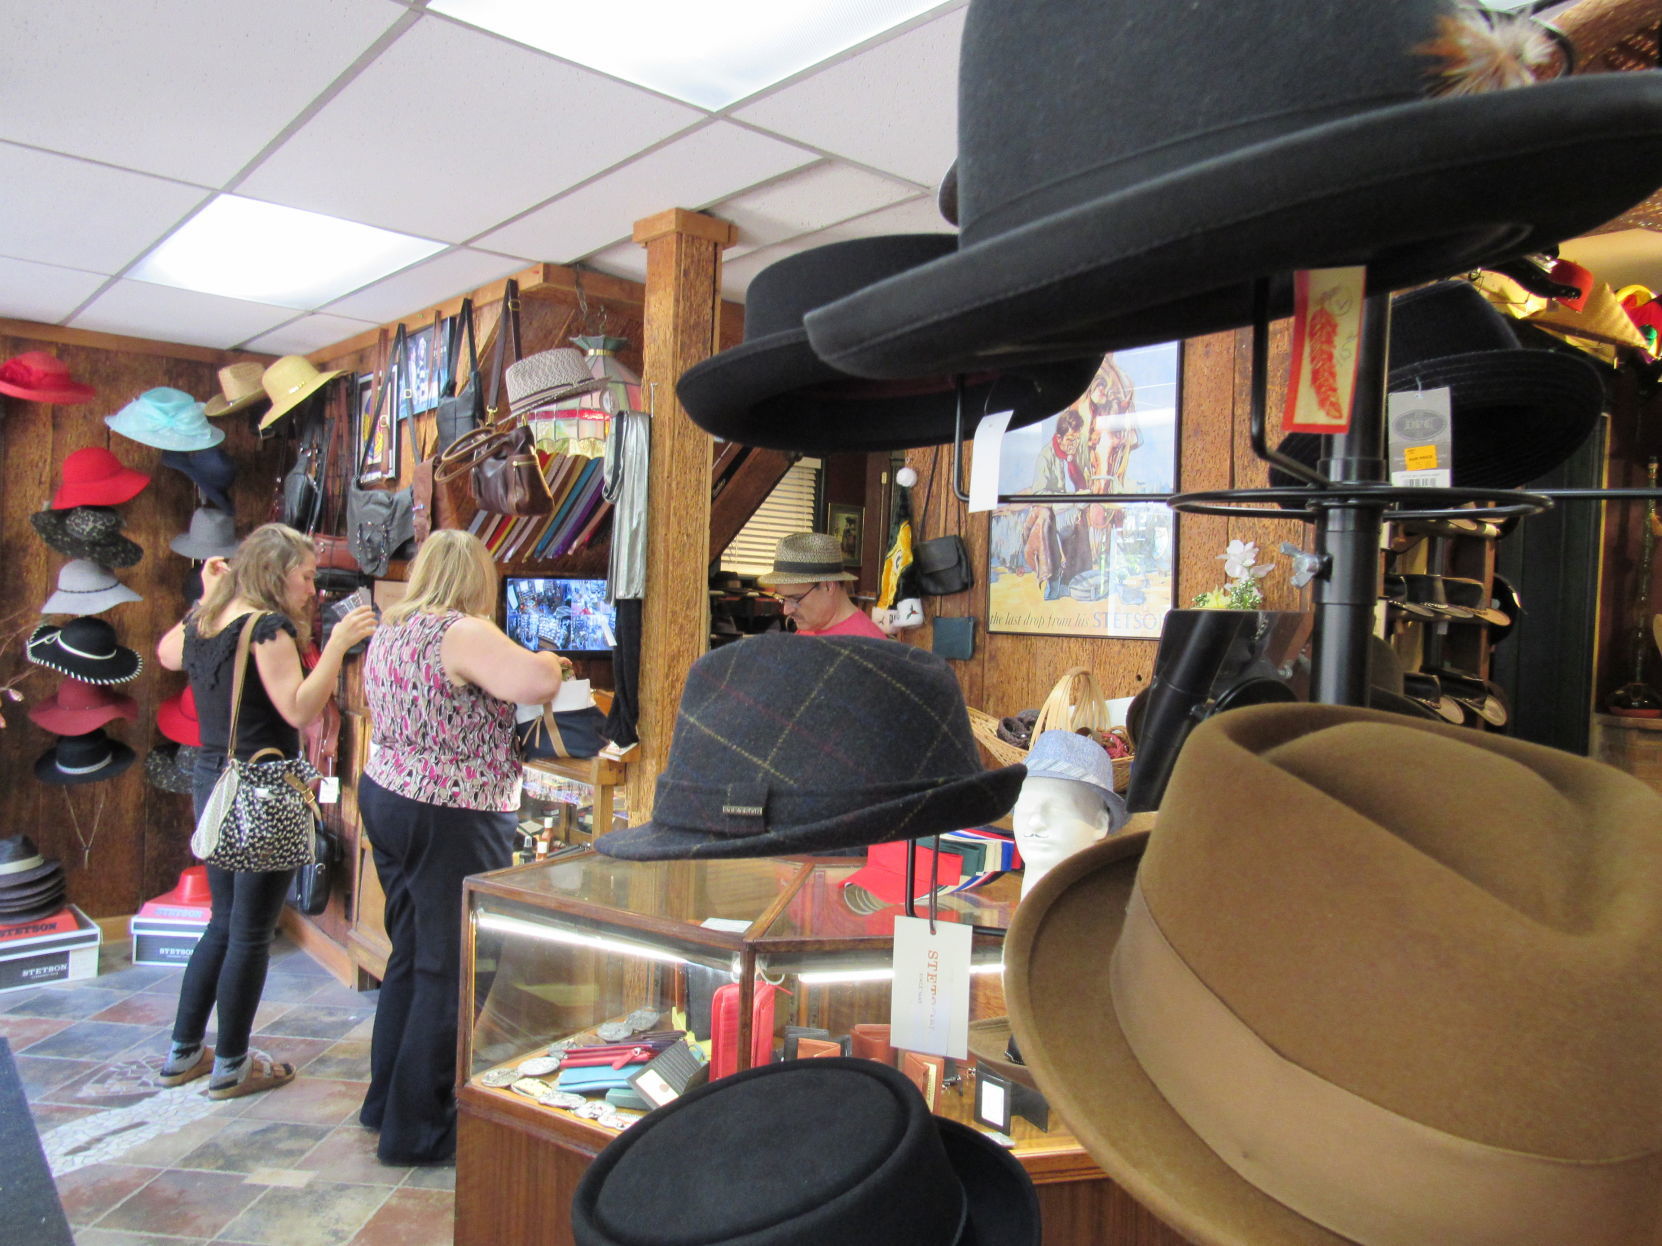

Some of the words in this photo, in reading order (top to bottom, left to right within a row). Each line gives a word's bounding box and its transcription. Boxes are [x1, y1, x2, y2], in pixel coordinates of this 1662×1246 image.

[990, 612, 1002, 625] the
[1005, 613, 1022, 626] last
[1023, 613, 1045, 628] drop
[1047, 613, 1072, 627] from
[1075, 613, 1089, 627] his
[22, 963, 67, 977] STETSON
[926, 950, 938, 1030] STET
